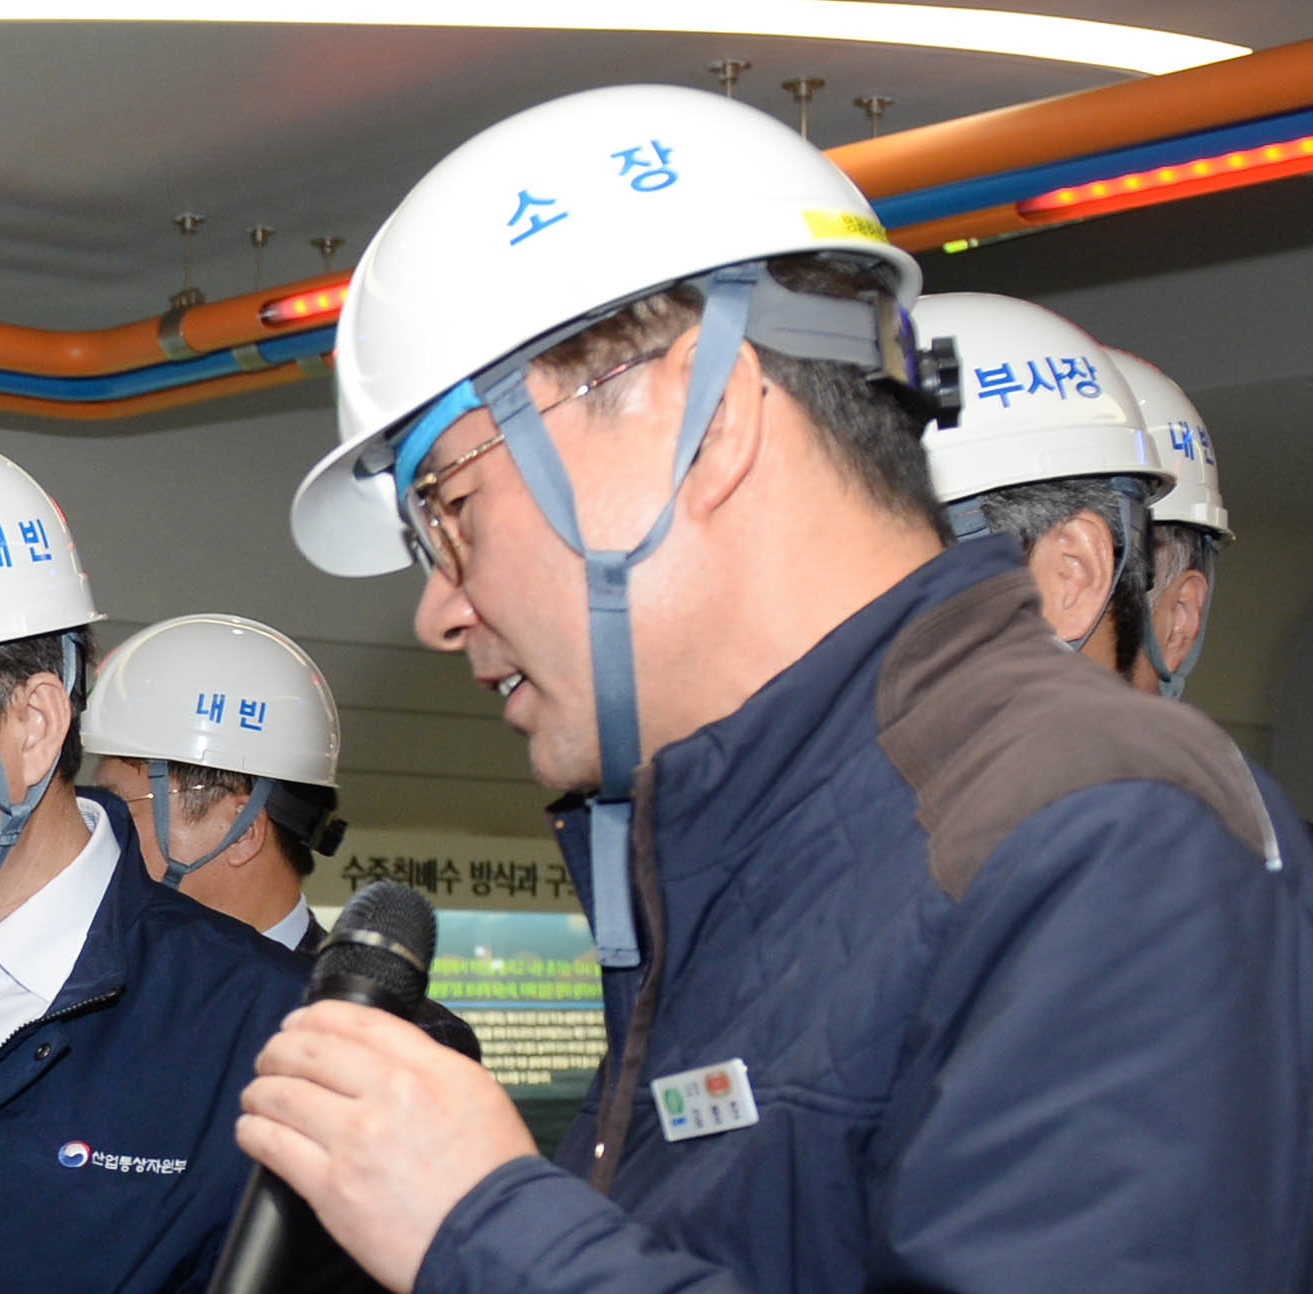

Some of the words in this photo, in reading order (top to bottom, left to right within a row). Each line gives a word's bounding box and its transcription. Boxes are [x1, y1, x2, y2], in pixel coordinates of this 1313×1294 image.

[974, 356, 1102, 409] 부사장
[470, 860, 538, 897] 방식과
[545, 864, 576, 899] 구
[91, 1151, 188, 1174] 산업통상자원부
